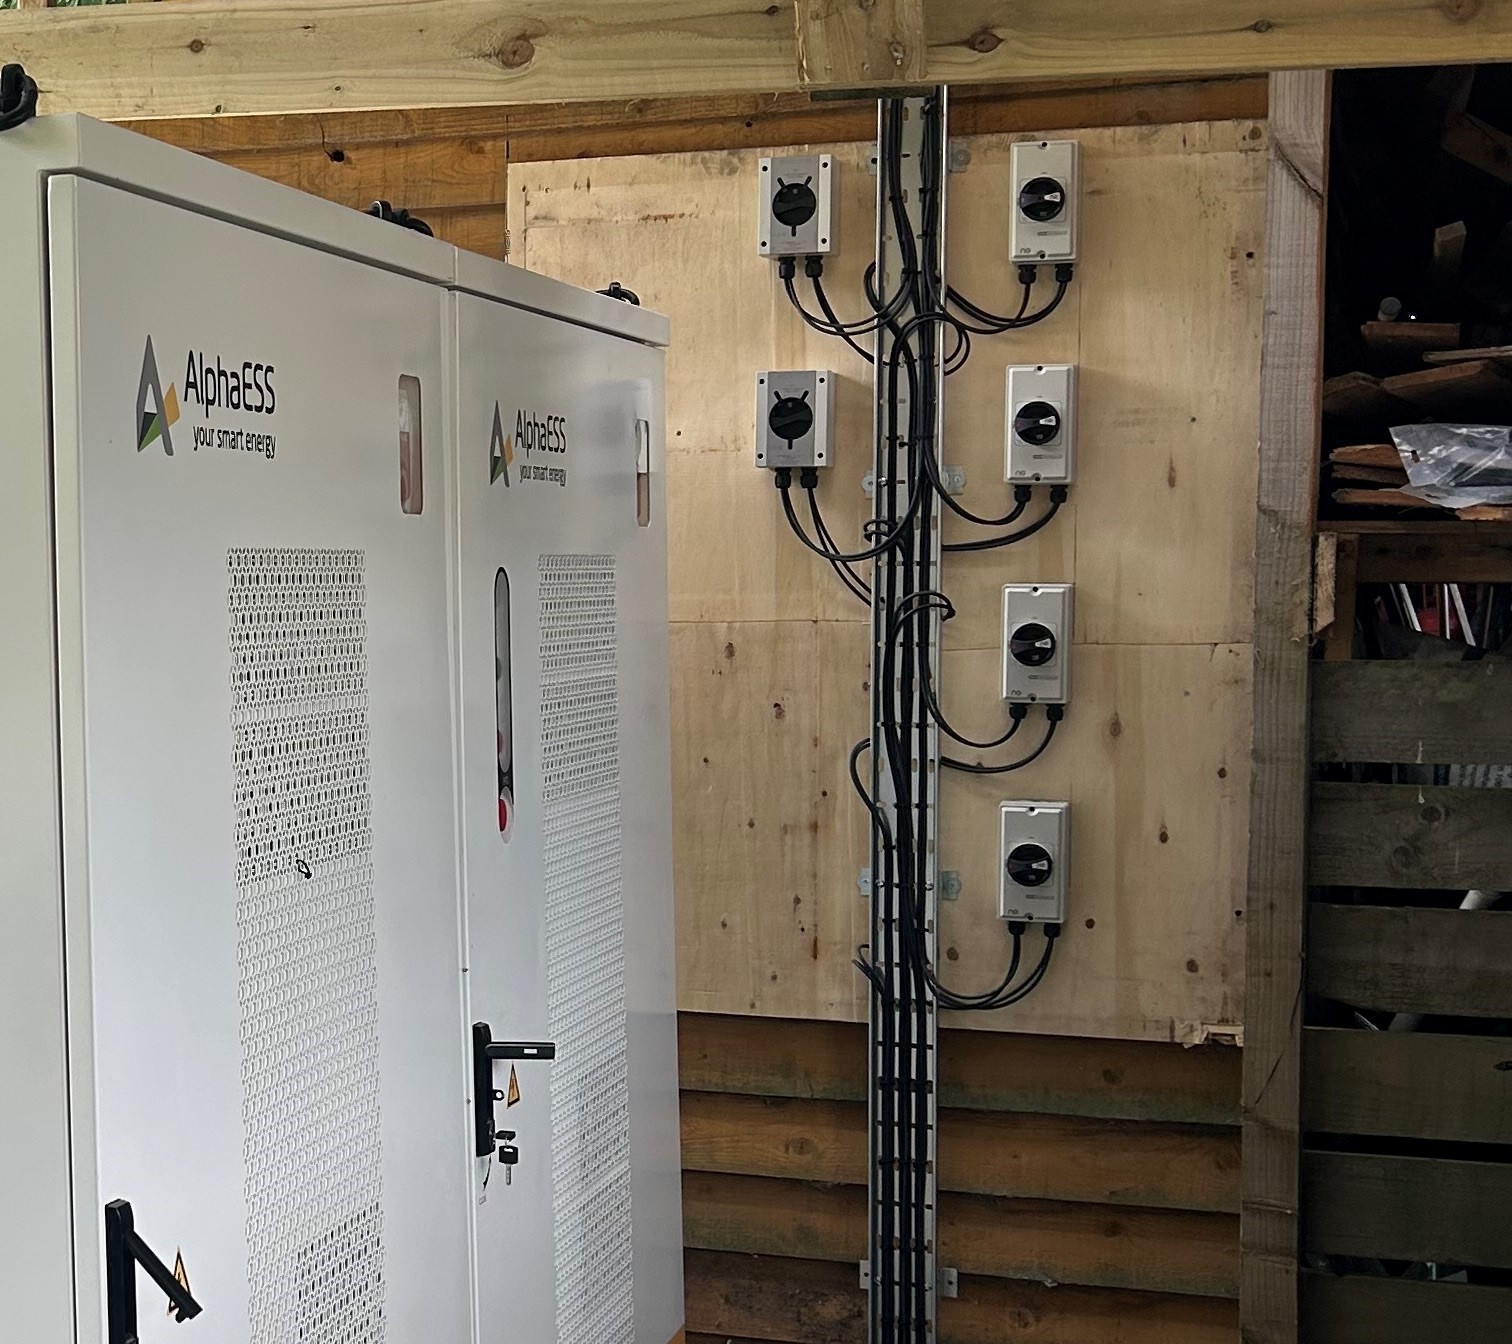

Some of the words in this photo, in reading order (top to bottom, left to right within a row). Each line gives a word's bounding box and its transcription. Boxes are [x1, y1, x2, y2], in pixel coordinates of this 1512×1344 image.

[183, 349, 276, 419] AlphaESS
[193, 425, 215, 452] your
[217, 428, 244, 451] smart
[246, 432, 276, 460] energy
[515, 408, 567, 459] AlphaESS
